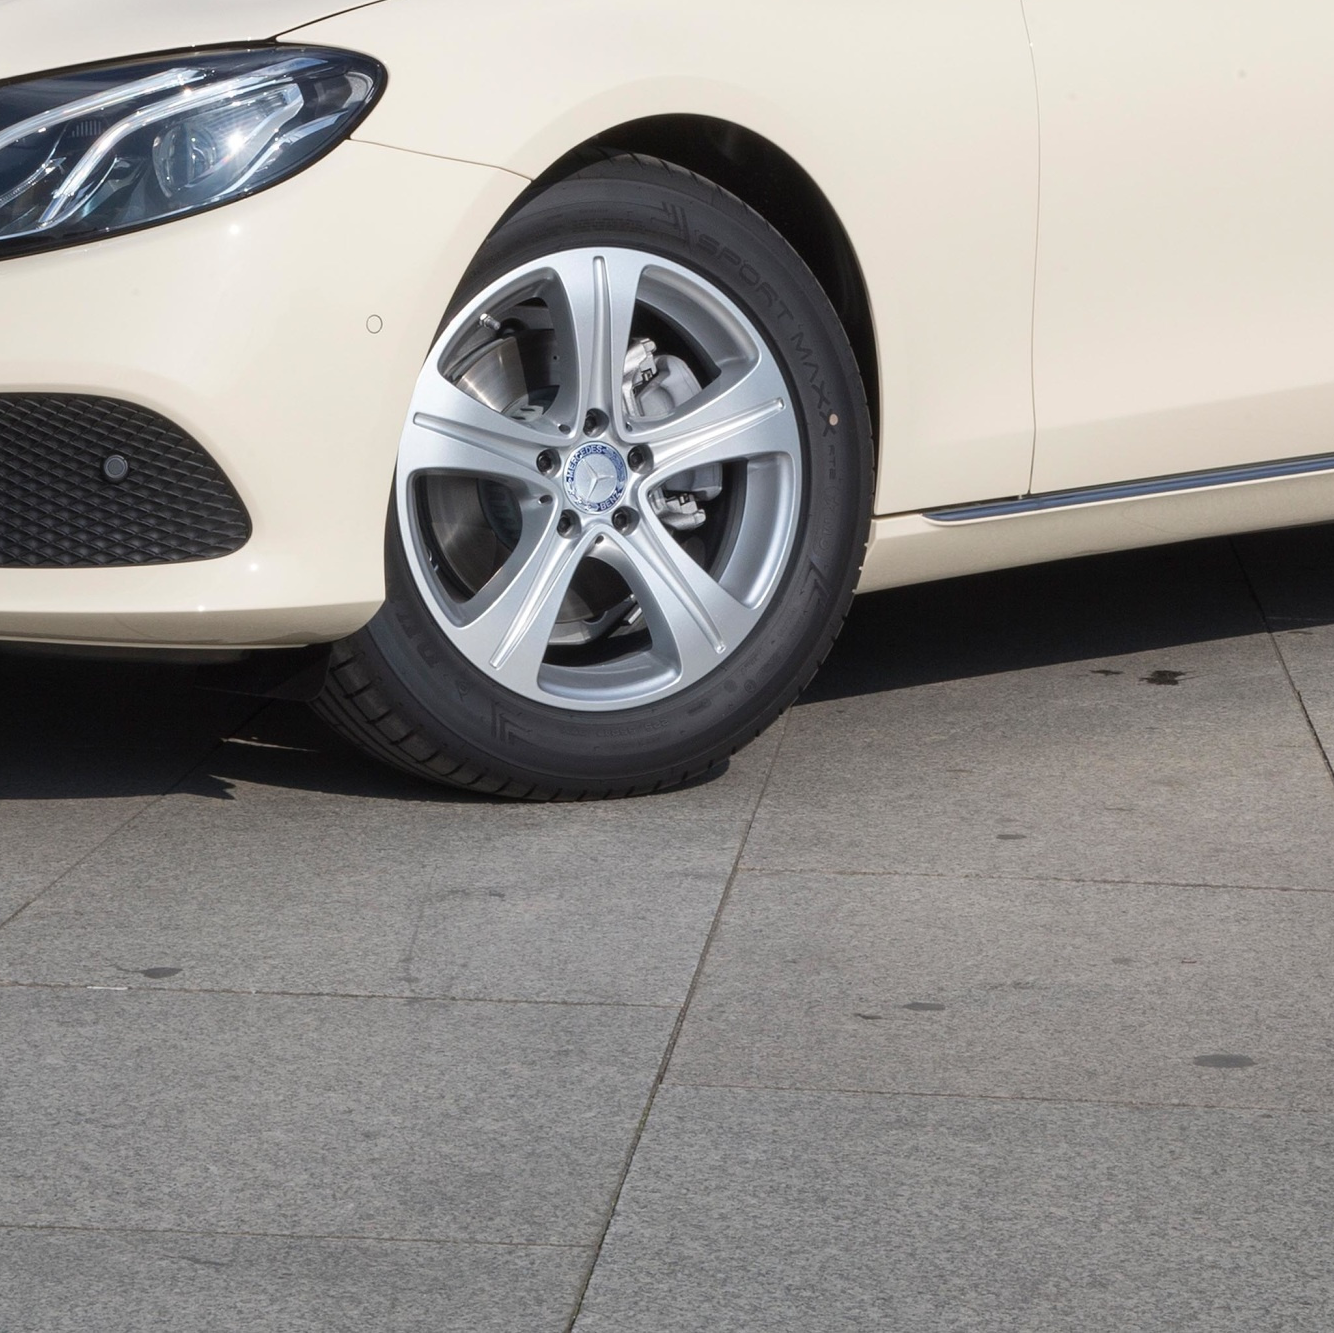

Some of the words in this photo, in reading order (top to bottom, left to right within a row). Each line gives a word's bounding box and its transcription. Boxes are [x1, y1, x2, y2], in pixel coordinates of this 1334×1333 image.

[697, 233, 794, 321] SPORT
[567, 445, 603, 479] MERCEDES
[599, 492, 621, 510] BENZ
